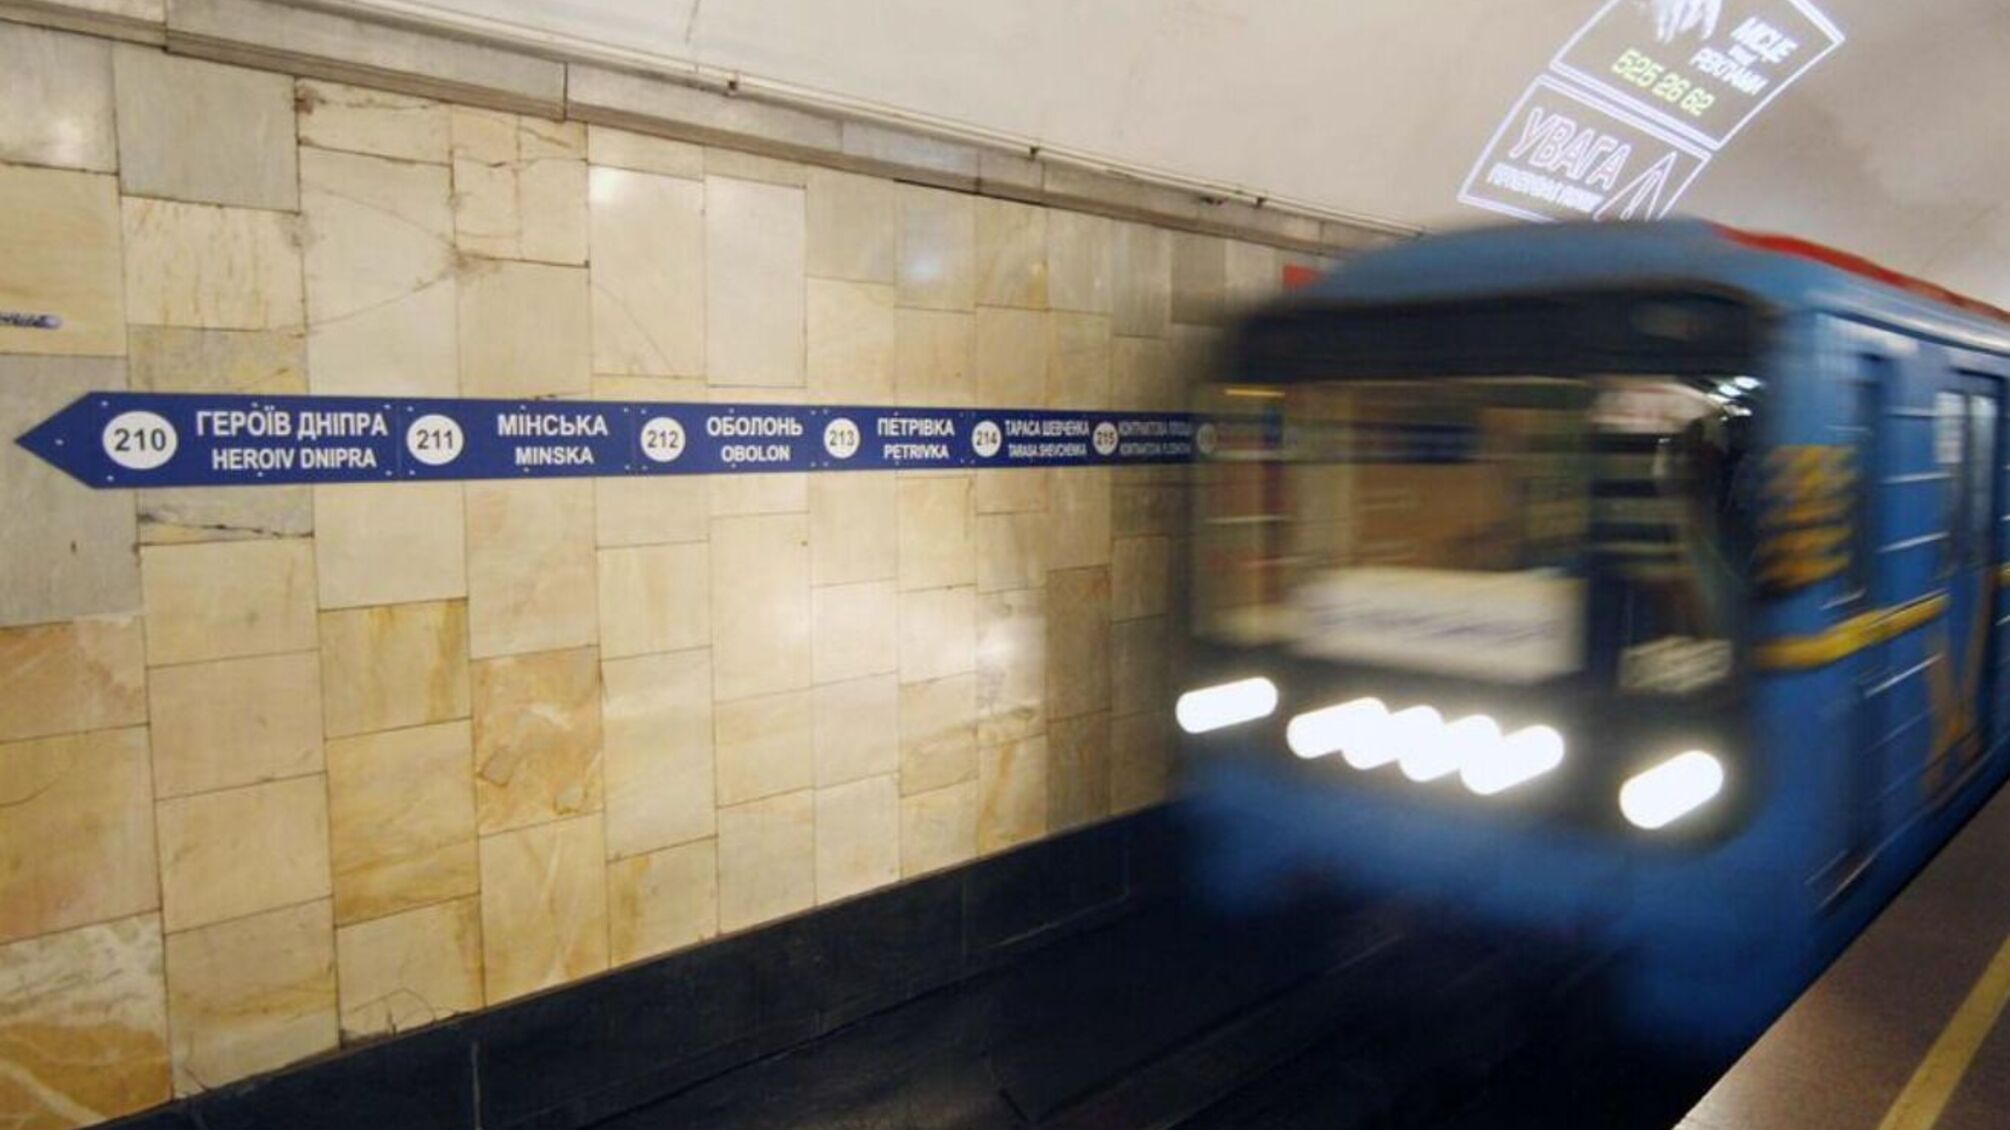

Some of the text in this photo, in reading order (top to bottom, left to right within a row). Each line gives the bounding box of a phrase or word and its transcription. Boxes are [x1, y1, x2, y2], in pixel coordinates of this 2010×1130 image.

[1652, 72, 1691, 103] 26
[1680, 87, 1715, 117] 62
[1509, 107, 1632, 190] УВАГА
[196, 405, 389, 441] ГЕРОЇВ ДНІПРА
[498, 412, 608, 437] МІНСЬКА
[706, 416, 804, 437] ОБОЛОНЬ
[877, 417, 955, 437] ПЕТРІВКА
[1004, 419, 1041, 437] ТАРАСА
[113, 428, 167, 452] 210
[416, 429, 455, 451] 211
[646, 429, 680, 449] 212
[829, 429, 856, 448] 213
[976, 429, 998, 447] 214
[212, 447, 377, 470] HEROIV DNIPRA
[515, 445, 594, 466] MINSKA
[720, 444, 791, 463] OBOLON
[883, 443, 950, 460] PETRIVKA
